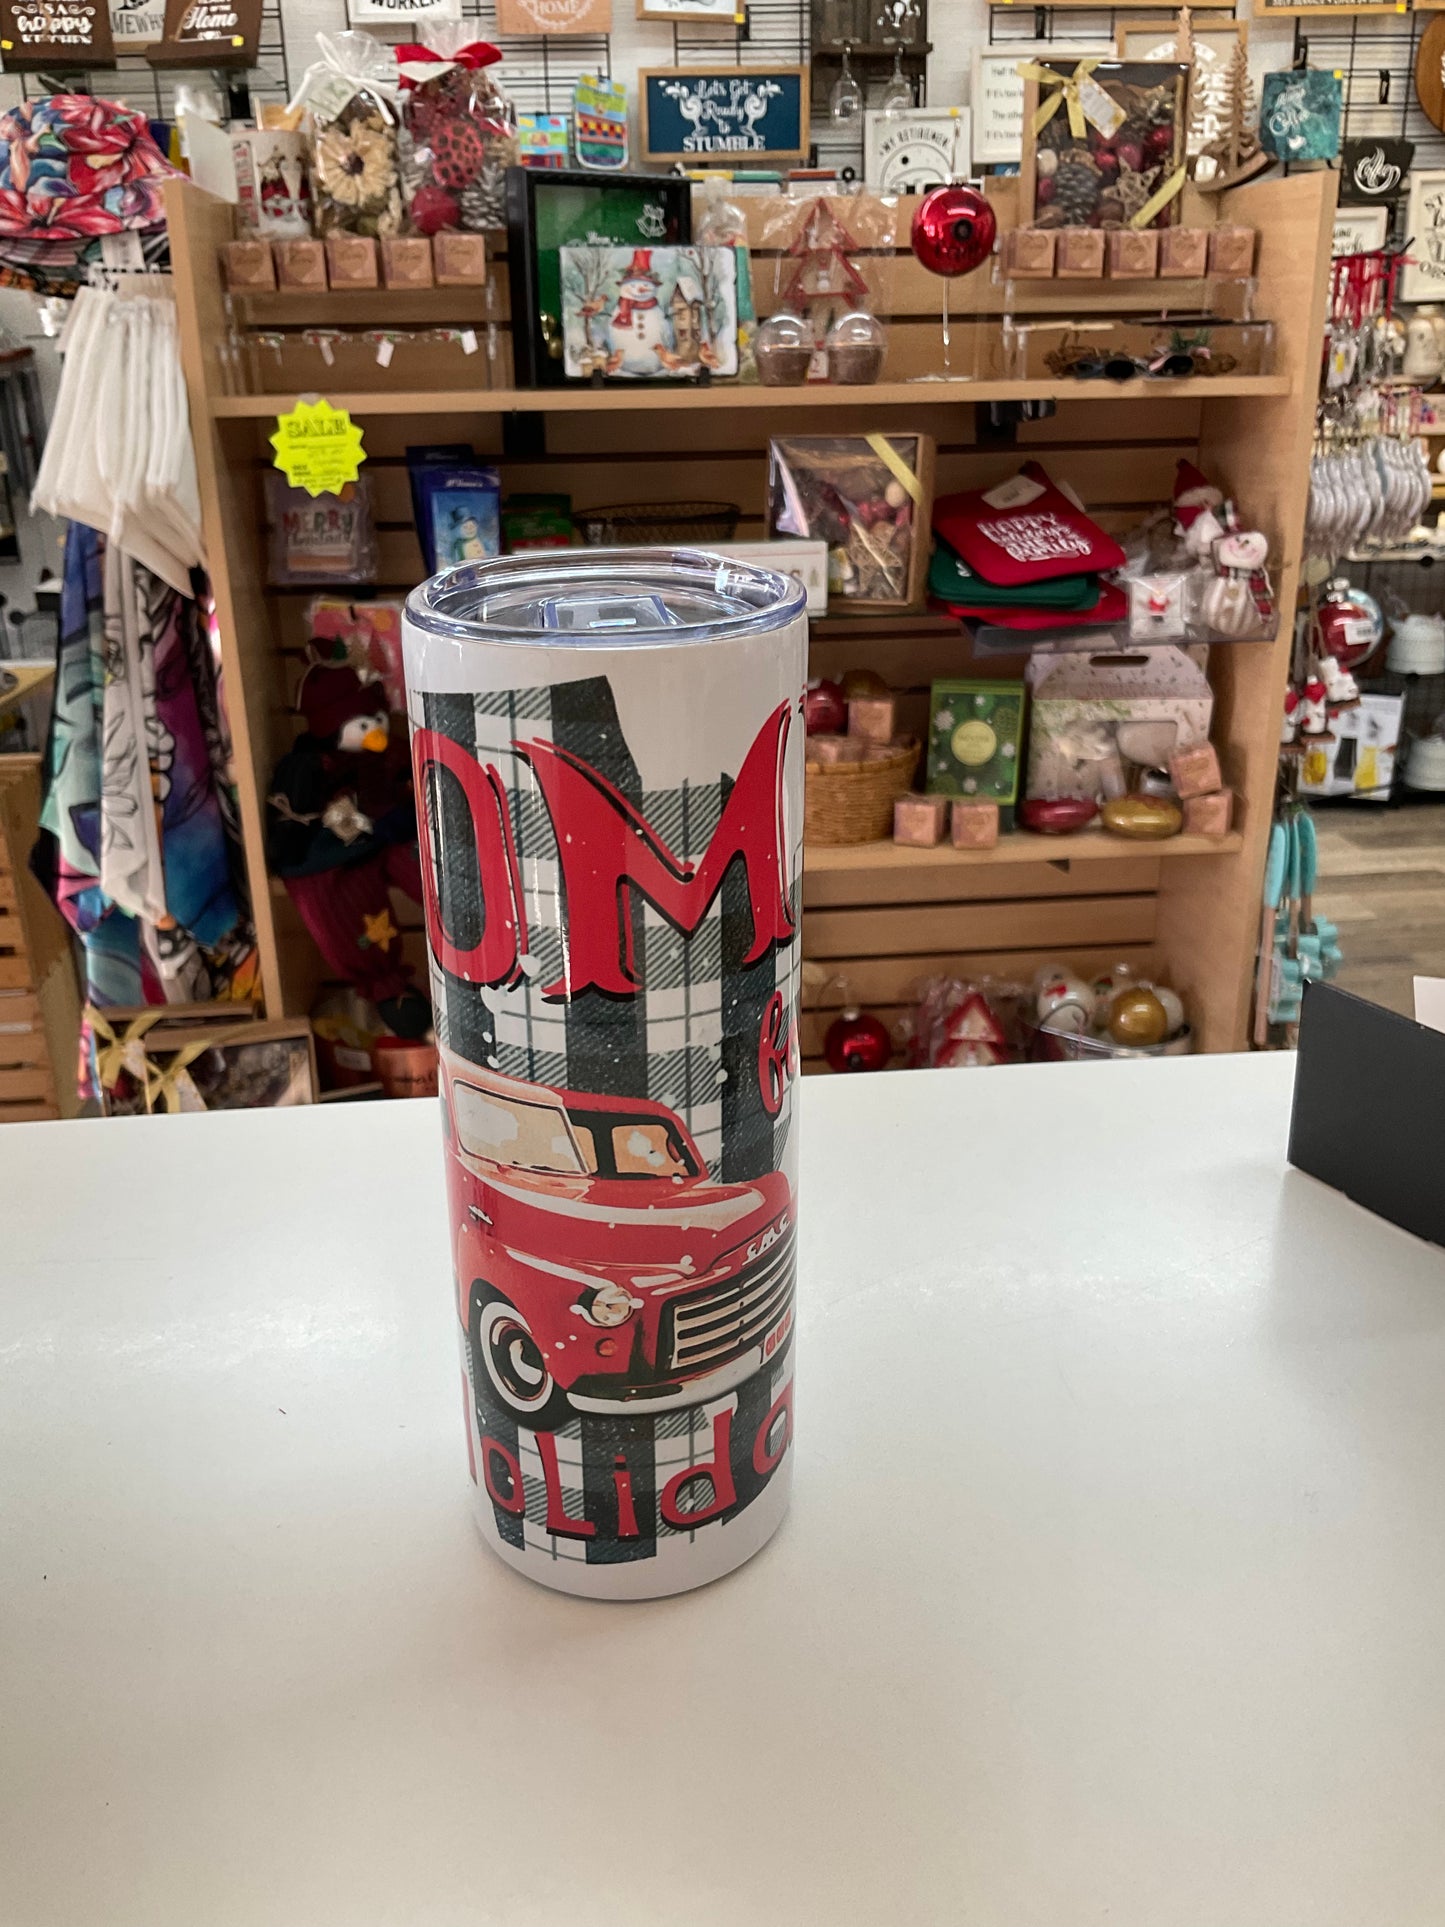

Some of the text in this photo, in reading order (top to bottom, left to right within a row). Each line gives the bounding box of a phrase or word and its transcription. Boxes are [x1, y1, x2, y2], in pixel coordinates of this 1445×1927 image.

[371, 0, 441, 10] WORKE
[683, 135, 766, 152] STUMBLE
[287, 418, 347, 438] SALE
